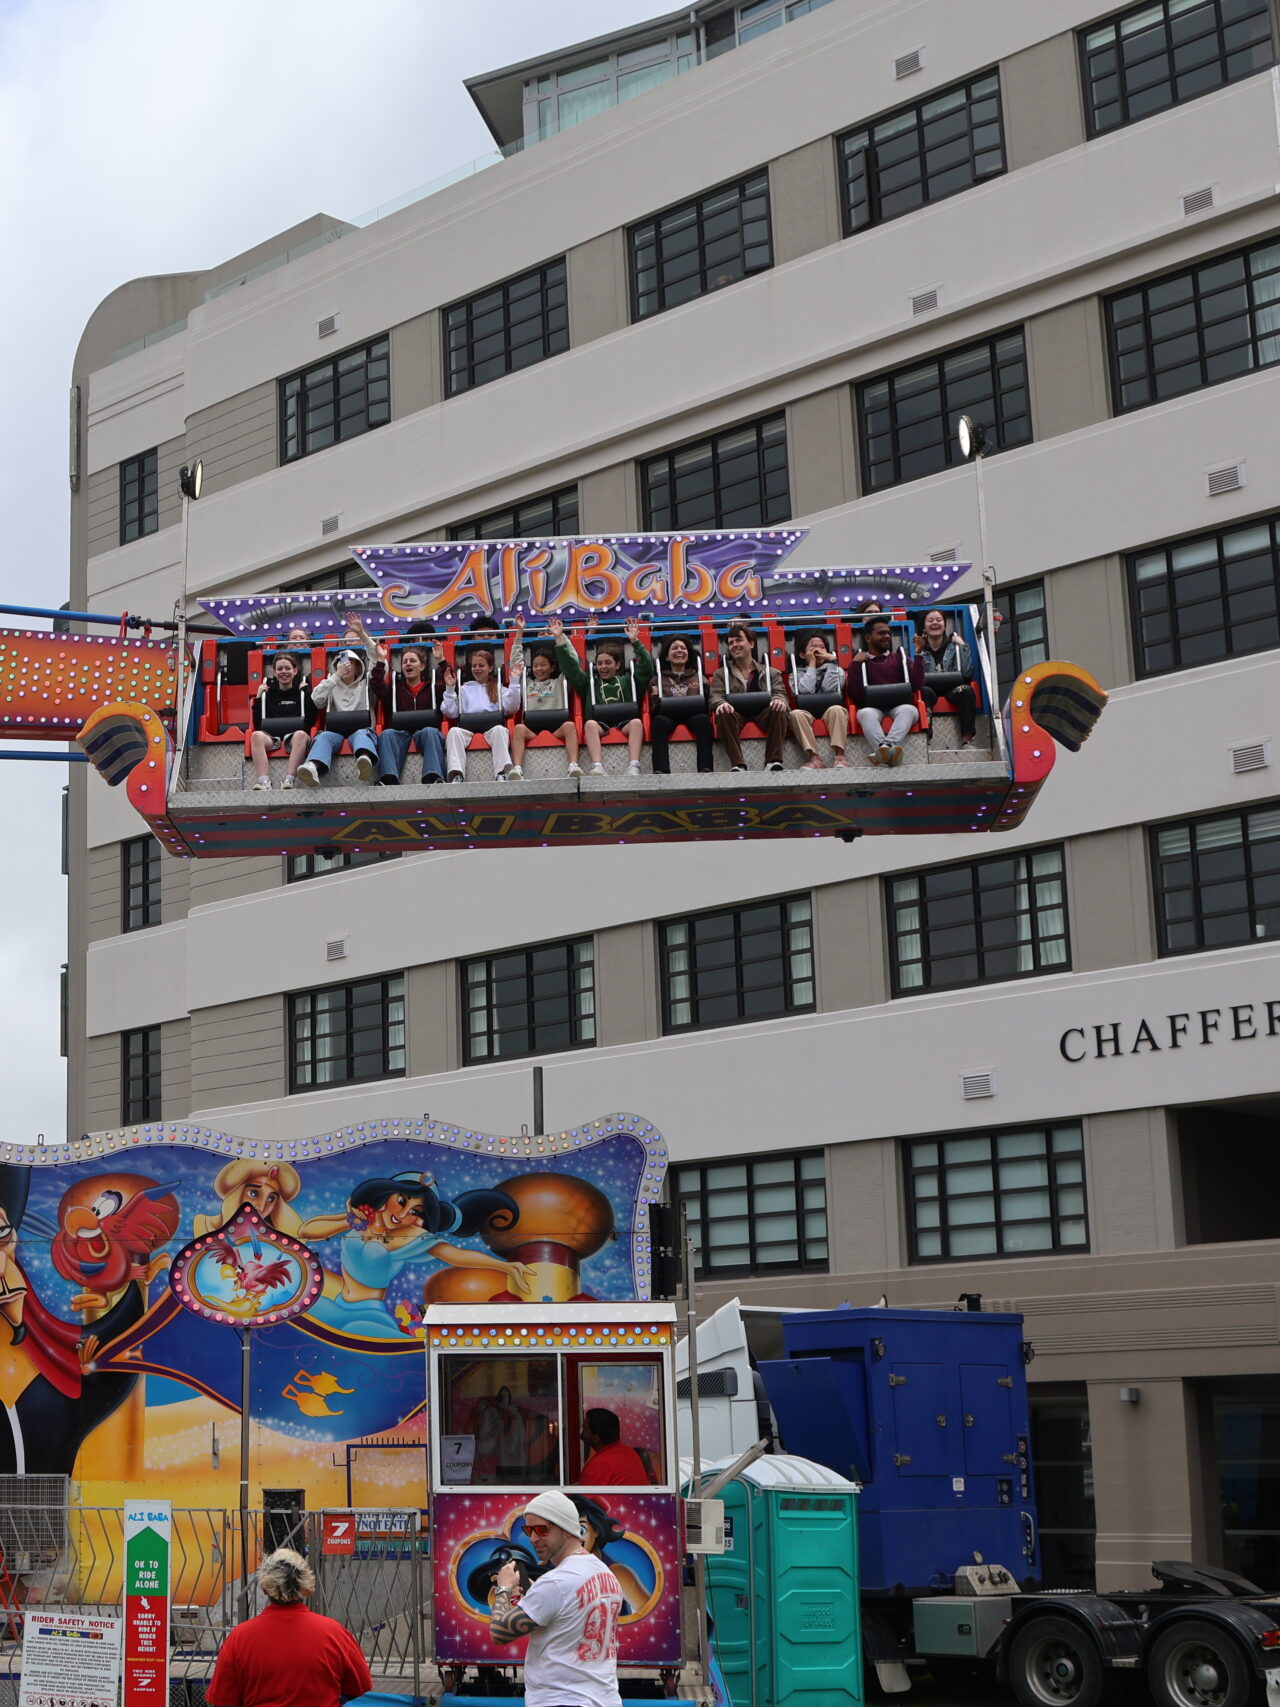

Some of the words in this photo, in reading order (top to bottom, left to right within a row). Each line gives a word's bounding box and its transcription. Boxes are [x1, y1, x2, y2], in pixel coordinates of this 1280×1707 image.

[330, 813, 518, 842] ALI
[540, 803, 854, 836] BABA
[454, 1442, 462, 1455] 7
[128, 1512, 145, 1521] ALI
[147, 1512, 169, 1522] BABA
[331, 1522, 349, 1536] 7
[134, 1560, 145, 1569] OK
[149, 1560, 159, 1569] TO
[138, 1571, 156, 1579] RIDE
[135, 1581, 159, 1589] ALONE
[31, 1615, 55, 1624] RIDER
[58, 1617, 85, 1627] SAFETY
[88, 1620, 115, 1629] NOTICE
[137, 1678, 152, 1687] 7
